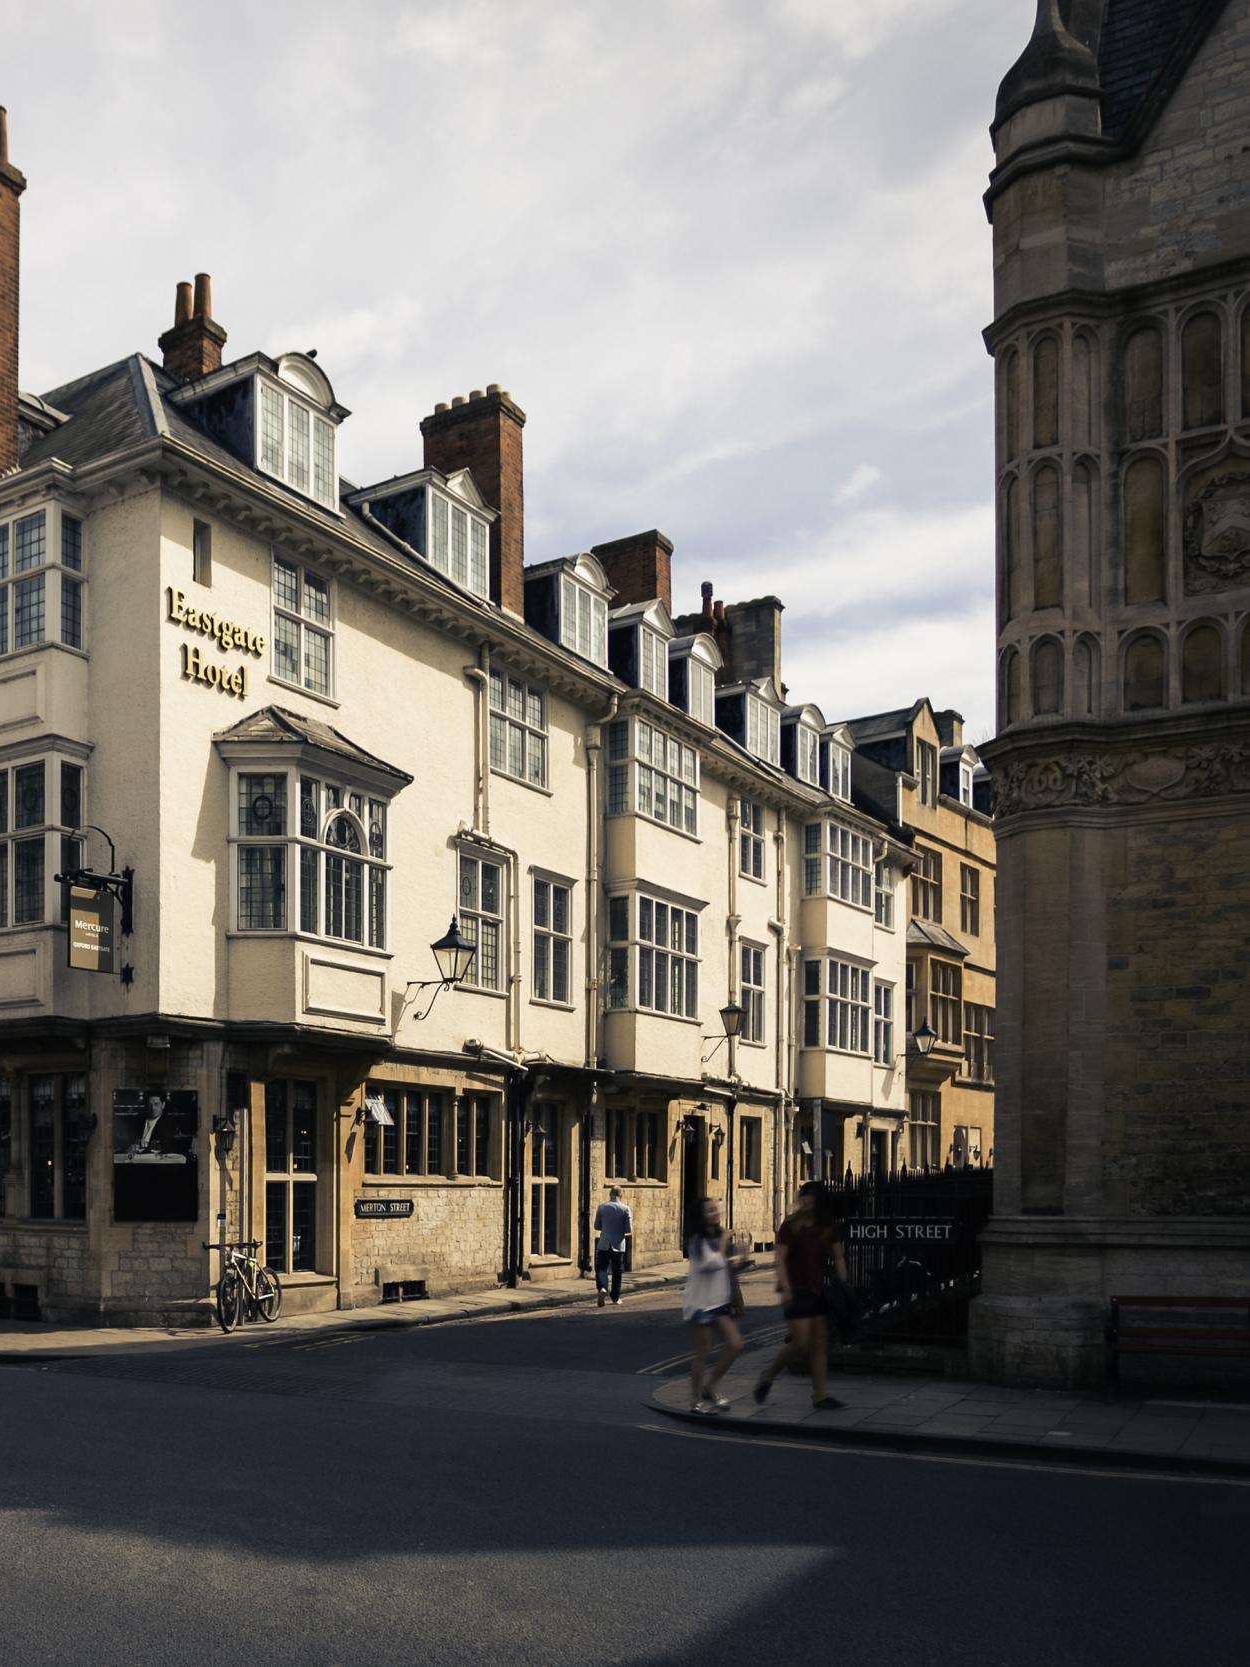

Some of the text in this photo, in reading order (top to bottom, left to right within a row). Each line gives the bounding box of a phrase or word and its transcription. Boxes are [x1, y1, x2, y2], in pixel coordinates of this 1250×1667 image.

[166, 586, 267, 656] Eastgate
[181, 642, 250, 699] Hotel
[74, 919, 110, 934] Mercure
[360, 1202, 410, 1212] MERTON STREET
[849, 1224, 953, 1239] HIGH STREET
